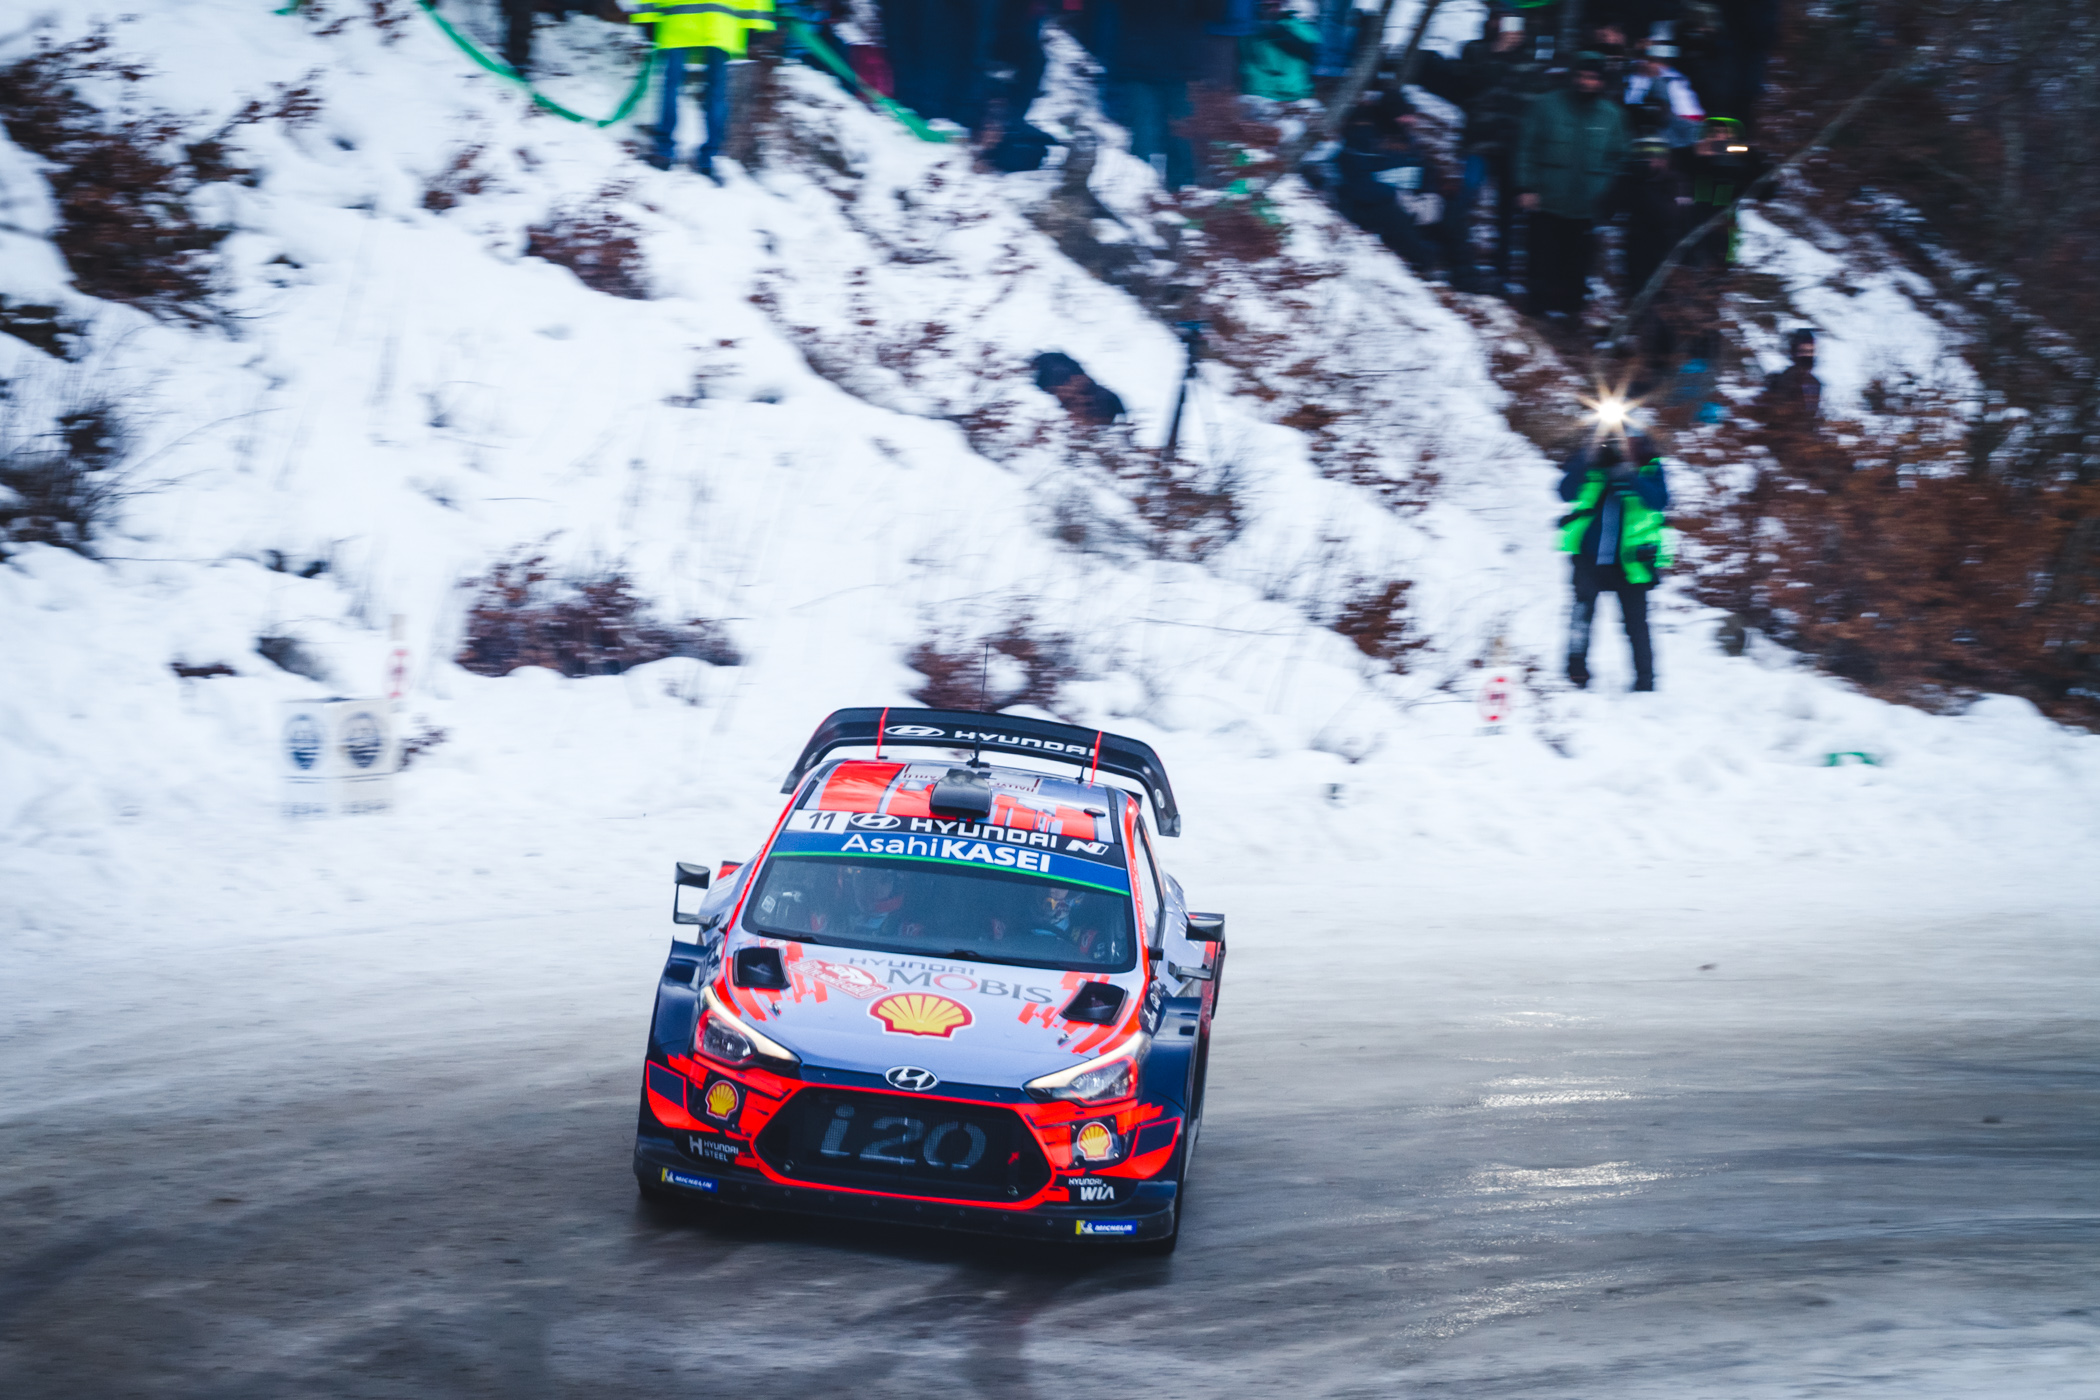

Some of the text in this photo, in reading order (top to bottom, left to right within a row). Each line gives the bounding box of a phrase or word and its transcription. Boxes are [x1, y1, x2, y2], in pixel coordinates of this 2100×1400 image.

[954, 730, 1097, 757] HYUNDAI
[808, 812, 836, 831] 11
[909, 817, 1057, 848] HYUNDAI
[849, 957, 974, 975] HYUNDAI
[887, 969, 1053, 1004] MOBIS
[820, 1104, 987, 1169] i20
[703, 1140, 739, 1155] HYUNDAI
[704, 1149, 729, 1162] STEEL
[674, 1175, 713, 1189] MICHELIN
[1068, 1177, 1103, 1186] HYUNDAI
[1080, 1183, 1115, 1201] WIA
[1094, 1224, 1133, 1232] MICHELIN
